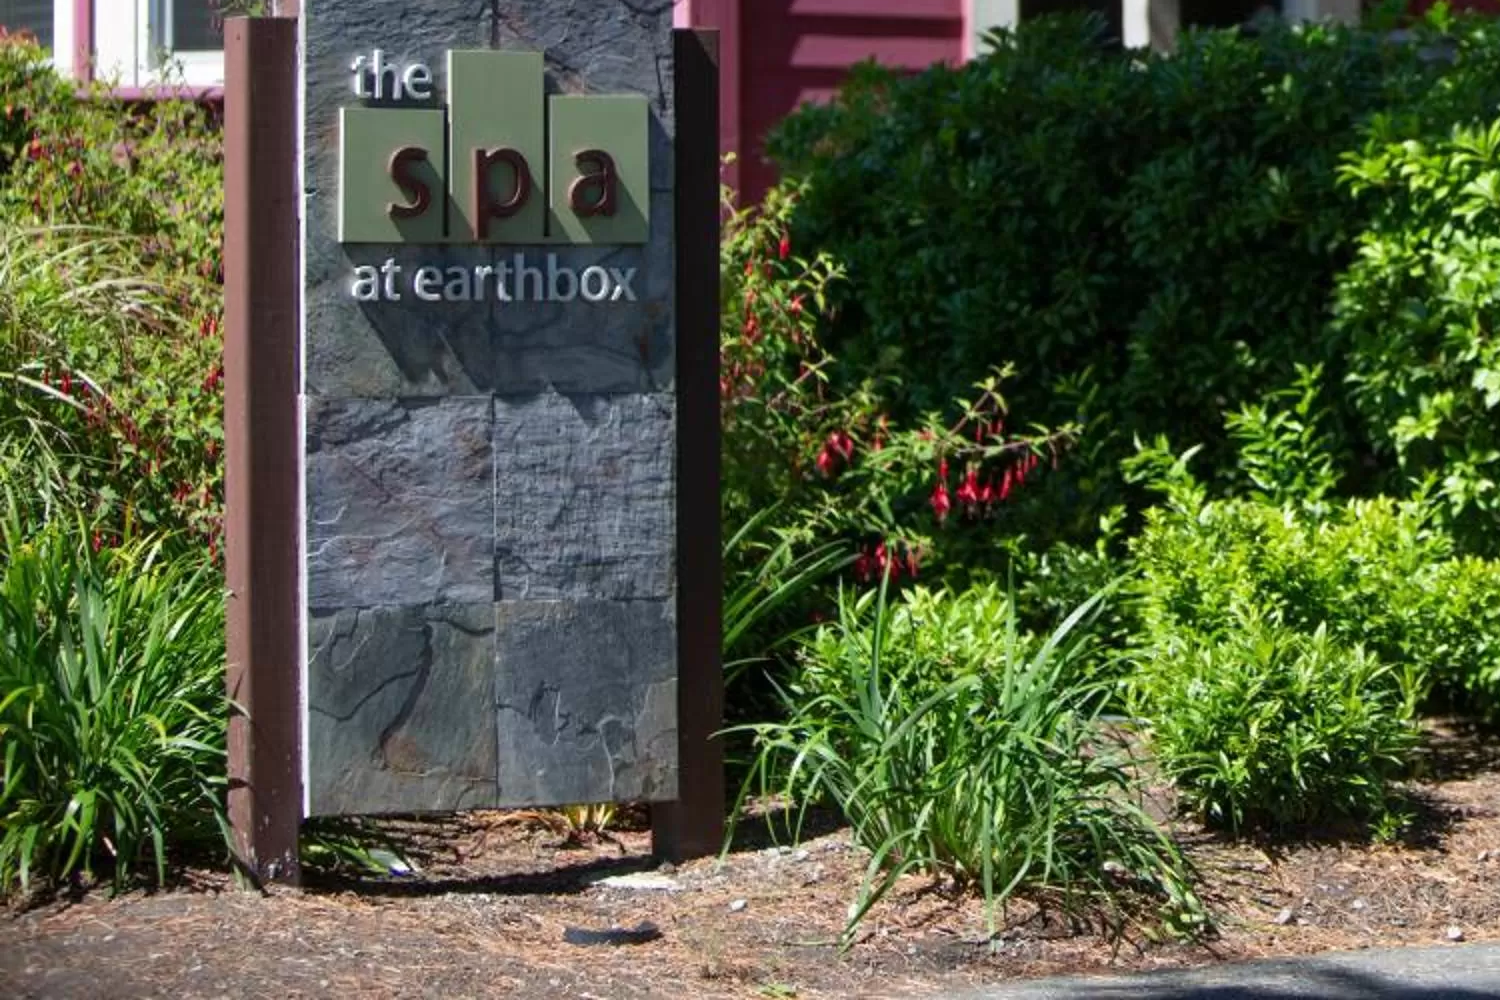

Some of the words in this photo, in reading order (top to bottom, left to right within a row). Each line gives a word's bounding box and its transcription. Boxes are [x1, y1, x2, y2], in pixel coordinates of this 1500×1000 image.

[351, 48, 433, 100] the
[387, 146, 618, 241] spa
[350, 256, 402, 301] at
[413, 252, 637, 302] earthbox
